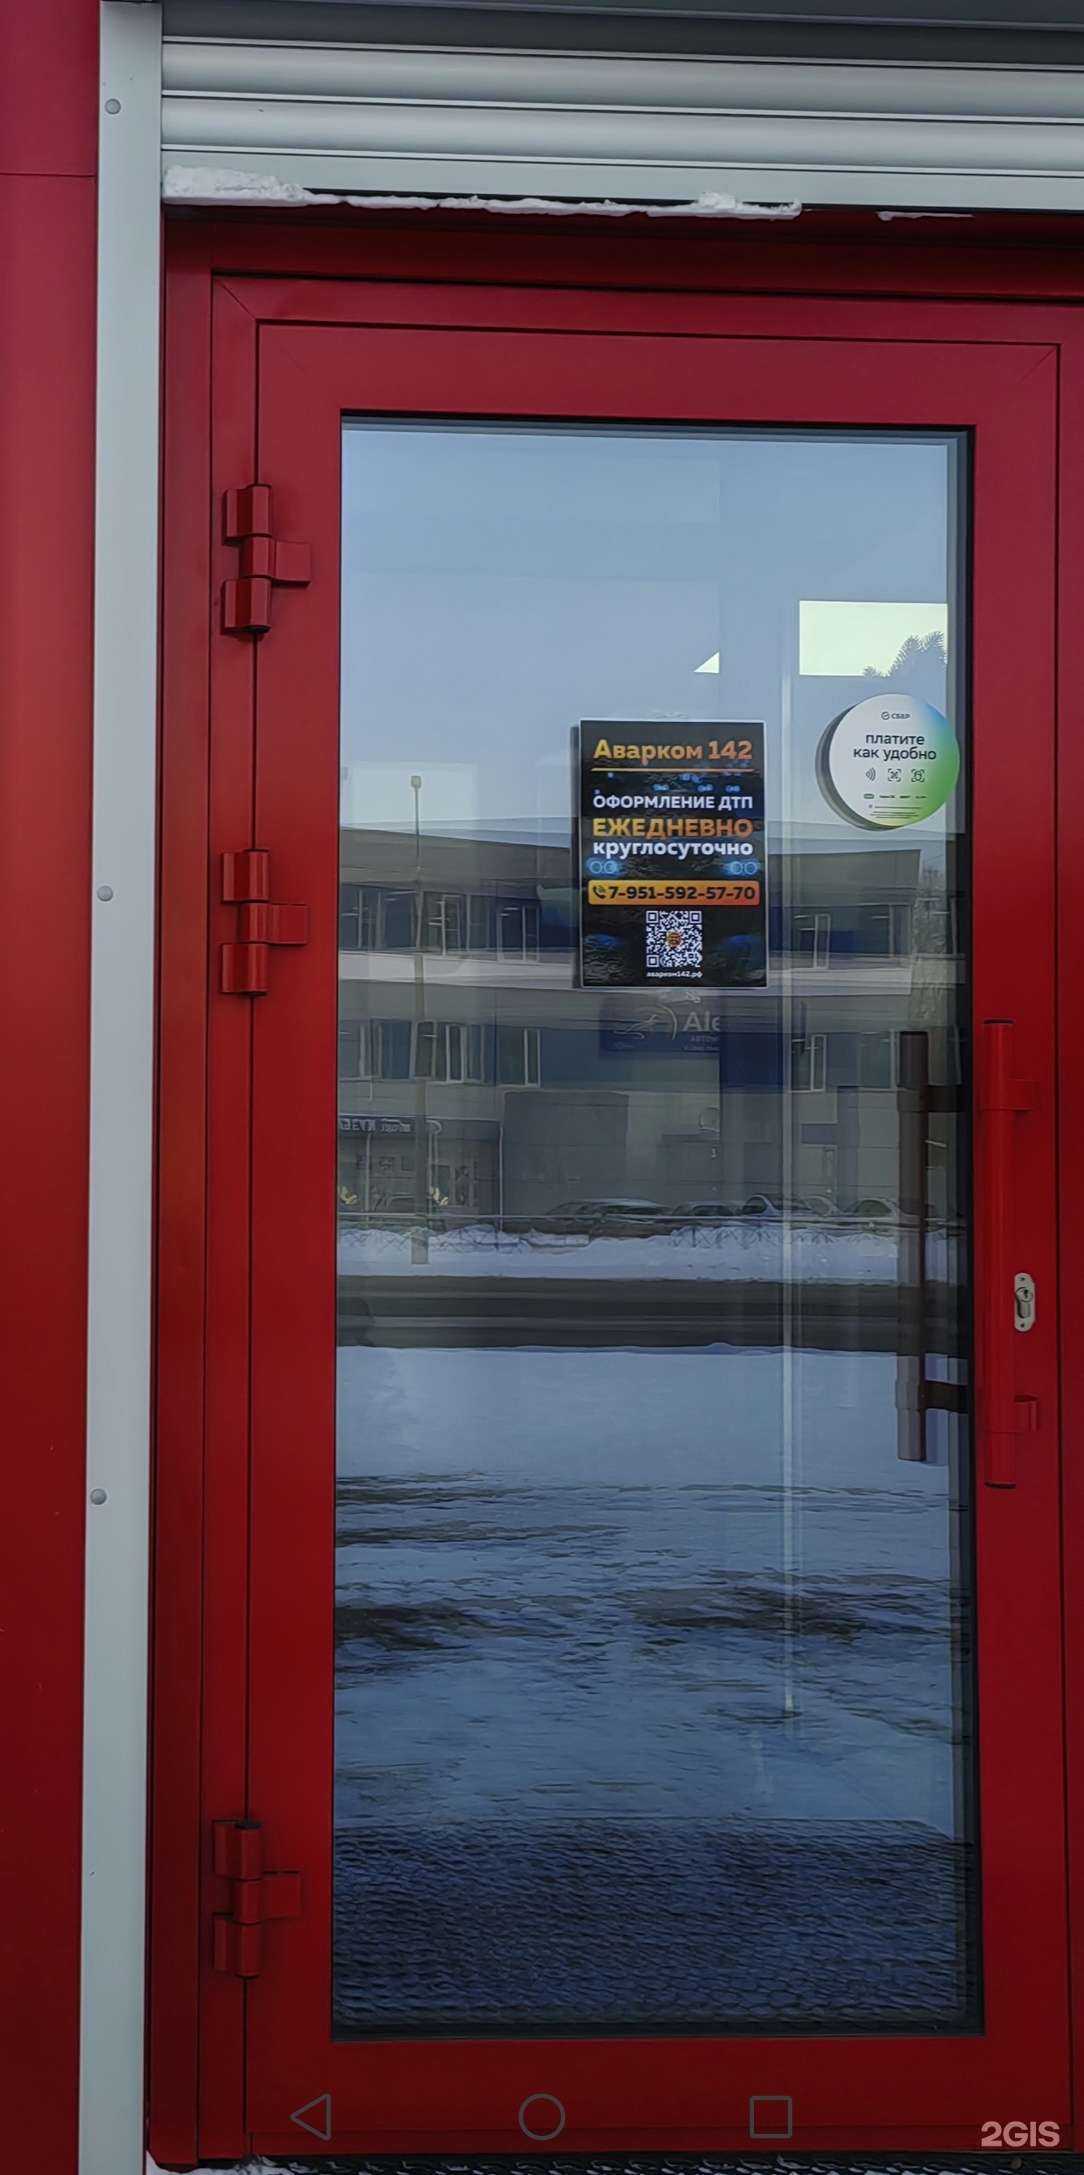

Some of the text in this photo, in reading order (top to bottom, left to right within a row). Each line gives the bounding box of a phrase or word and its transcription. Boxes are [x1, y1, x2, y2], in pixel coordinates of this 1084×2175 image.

[866, 734, 925, 745] платите
[594, 739, 753, 765] Аварком 142
[853, 747, 937, 761] как удобно
[593, 795, 753, 810] ОФОРМЛЕНИЕ ДТП
[593, 818, 753, 839] ЕЖЕДНЕВНО
[593, 842, 753, 859] круглосуточно
[609, 886, 755, 900] 7-951-592-57-70
